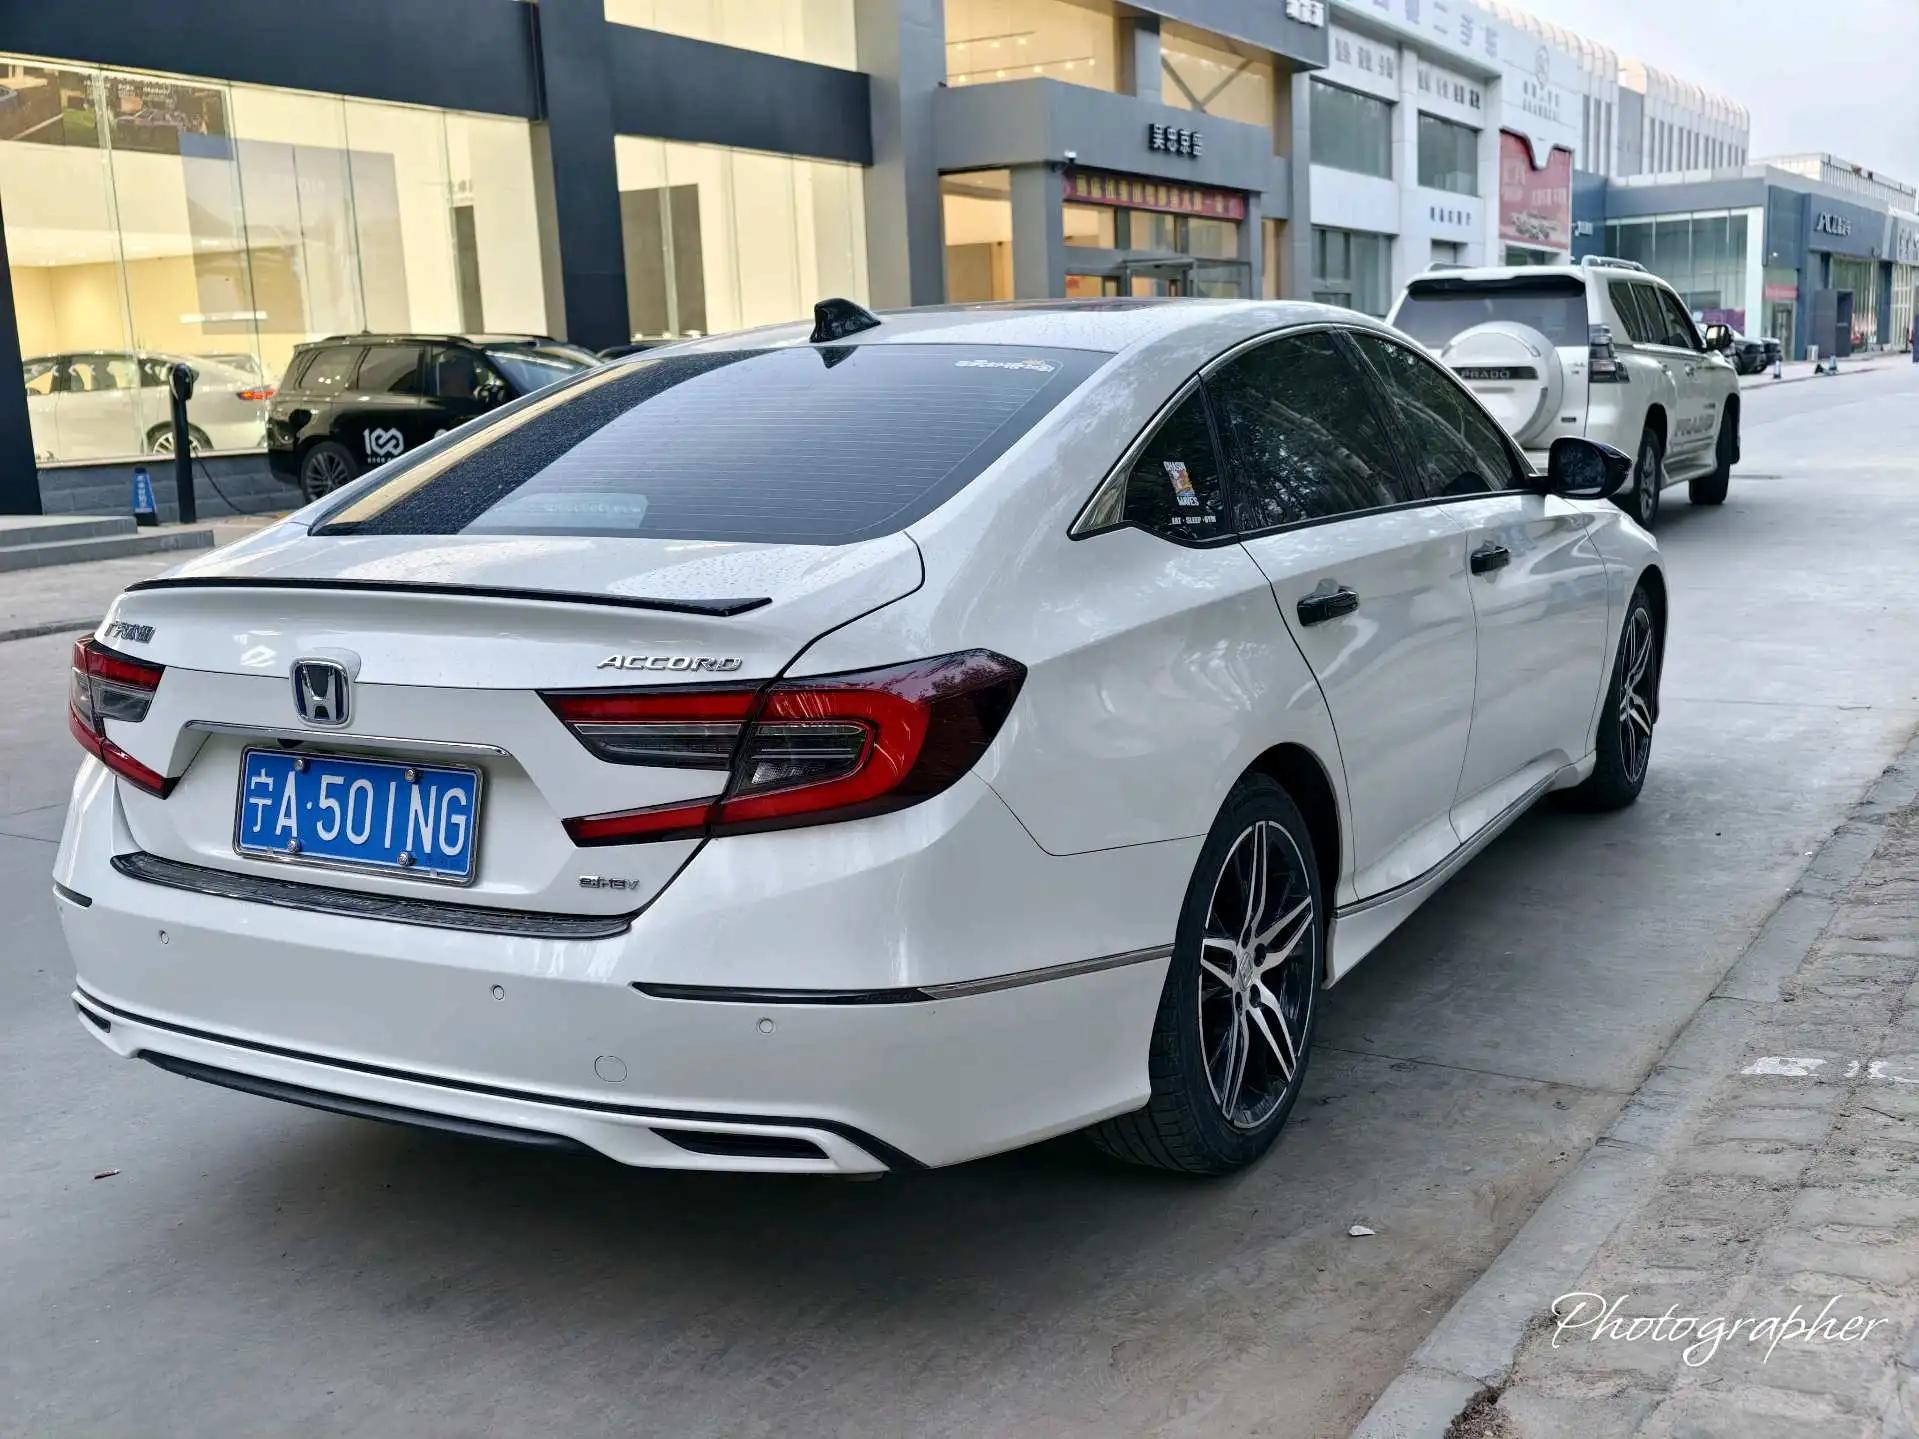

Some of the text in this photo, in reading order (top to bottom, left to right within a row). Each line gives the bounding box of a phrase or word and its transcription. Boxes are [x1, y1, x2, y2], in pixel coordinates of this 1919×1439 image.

[1460, 368, 1511, 380] PRADO
[1176, 496, 1200, 506] WAVES
[596, 653, 743, 673] ACCORD
